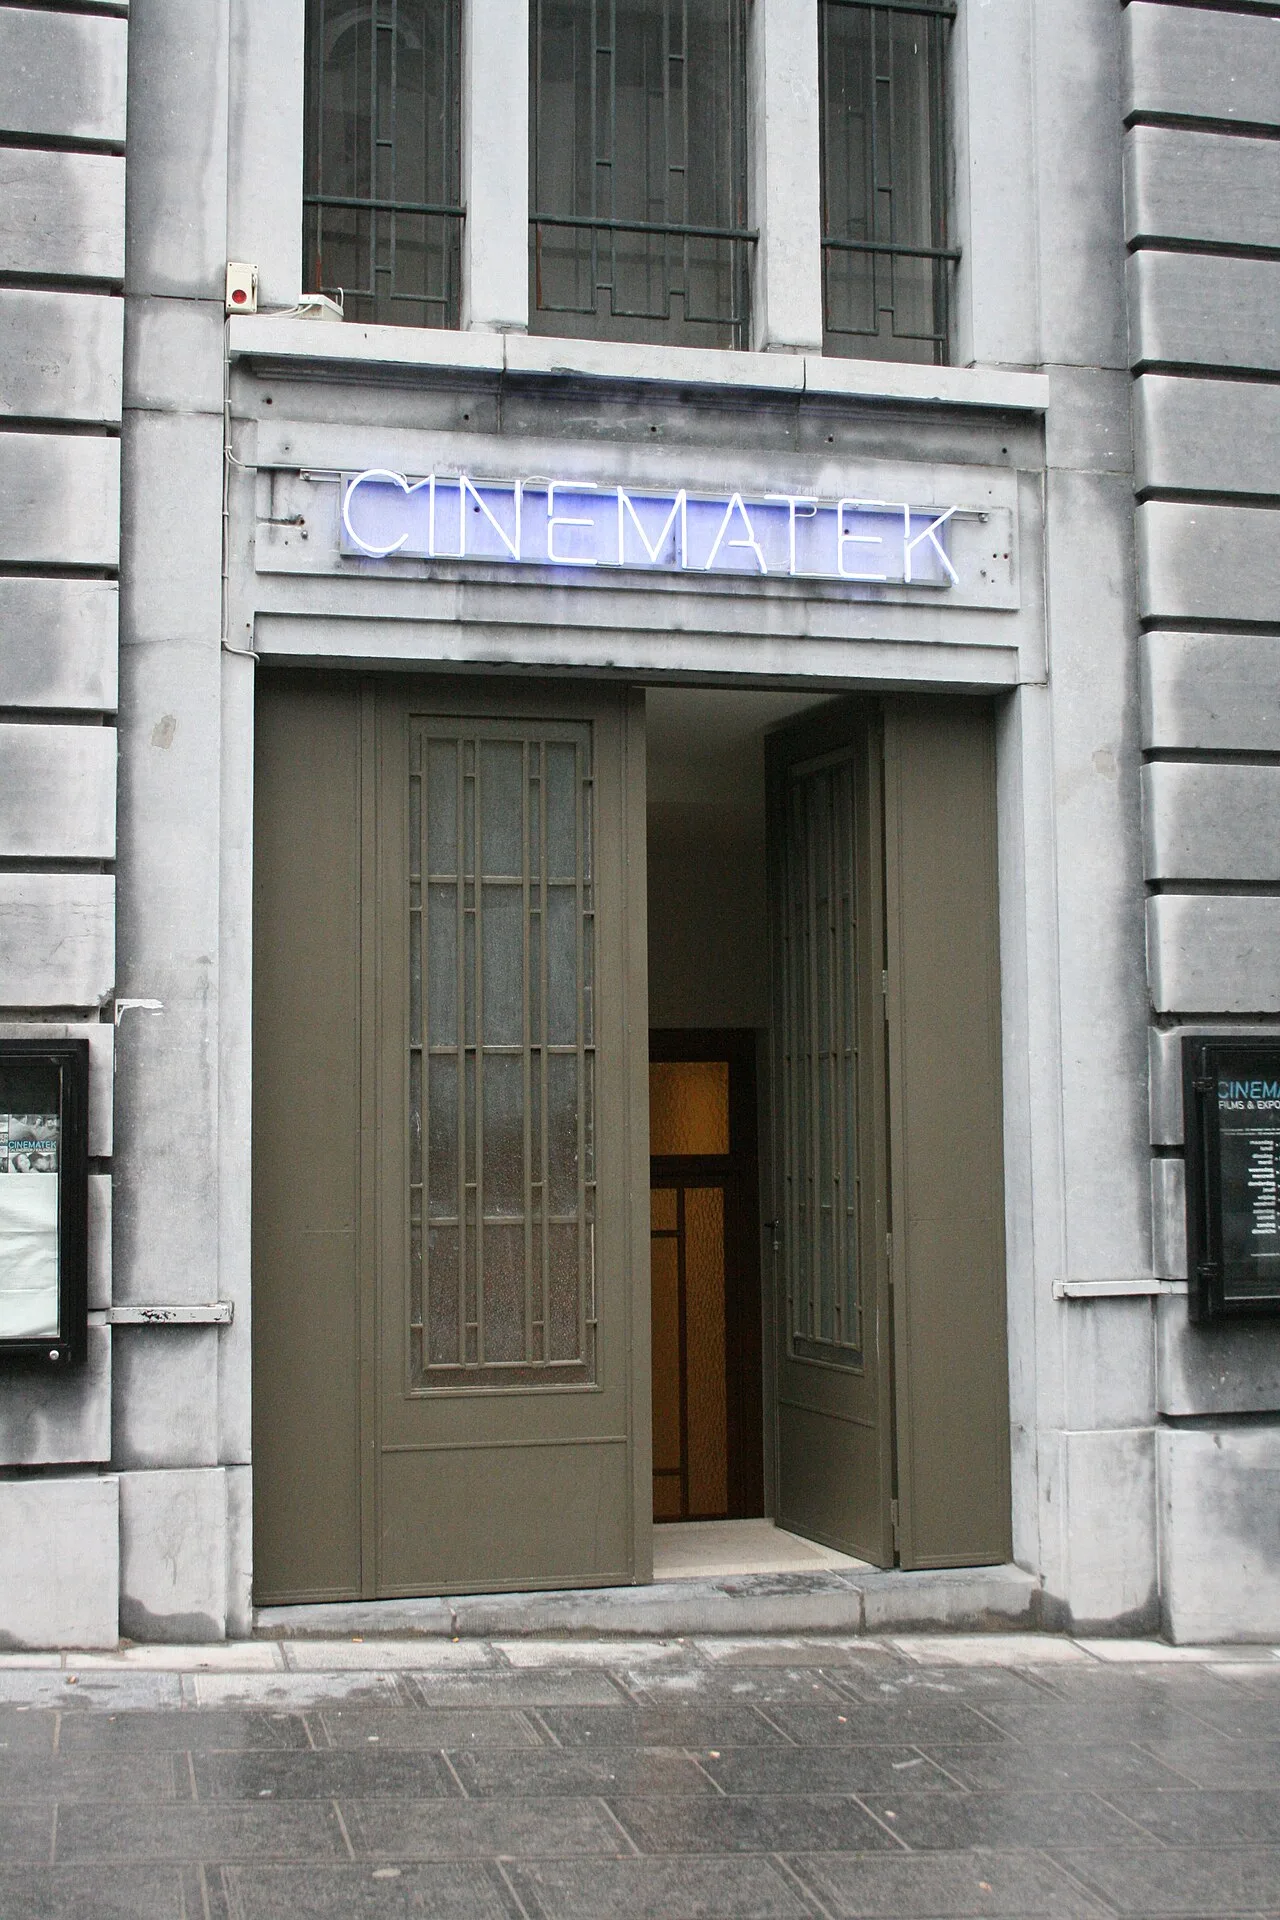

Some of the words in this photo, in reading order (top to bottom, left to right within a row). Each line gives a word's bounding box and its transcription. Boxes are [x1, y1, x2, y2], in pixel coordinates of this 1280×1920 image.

[342, 467, 960, 586] CINEMATEK
[1217, 1080, 1280, 1099] CINEM
[1218, 1100, 1245, 1110] FILMS
[1246, 1100, 1255, 1110] &
[8, 1140, 57, 1149] CINEMATEK
